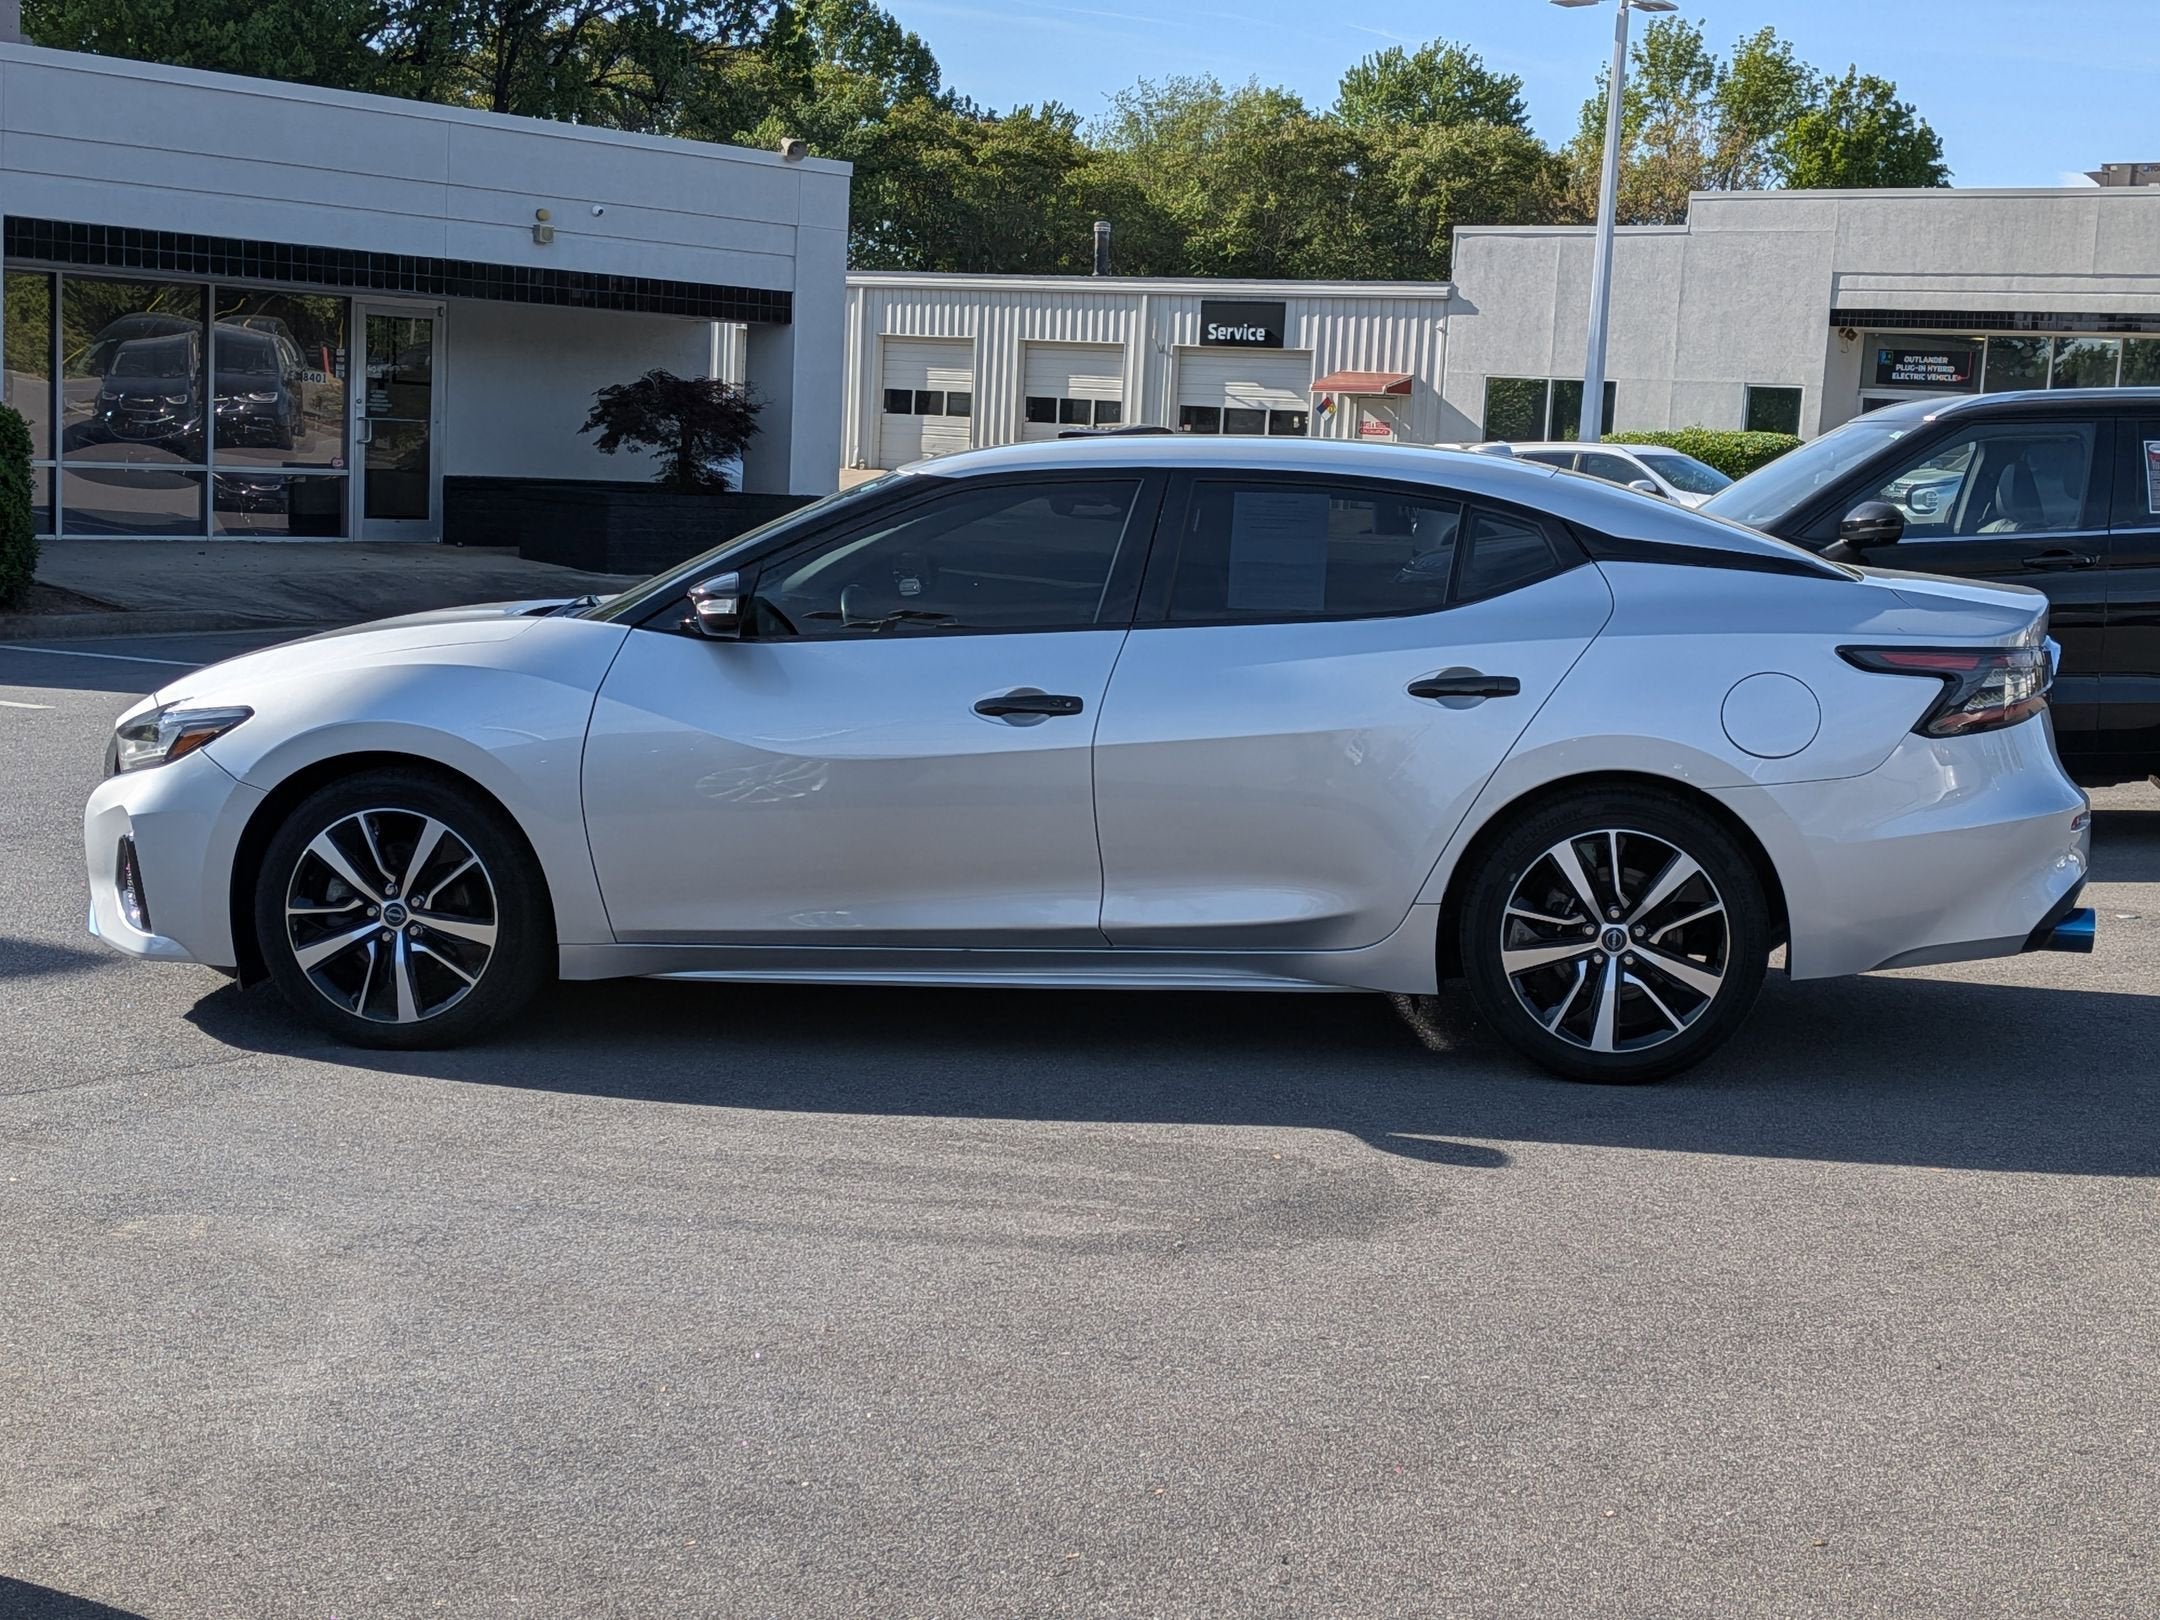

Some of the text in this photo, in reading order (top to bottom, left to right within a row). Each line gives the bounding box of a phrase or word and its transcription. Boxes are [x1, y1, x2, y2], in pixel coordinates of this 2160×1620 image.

[1207, 323, 1266, 341] Service
[1903, 355, 1949, 364] OUTLANDER
[1895, 363, 1956, 373] PLUG-IN HYBRID
[303, 372, 327, 383] 8401
[1891, 372, 1958, 382] ELECTRIC VEHICLE
